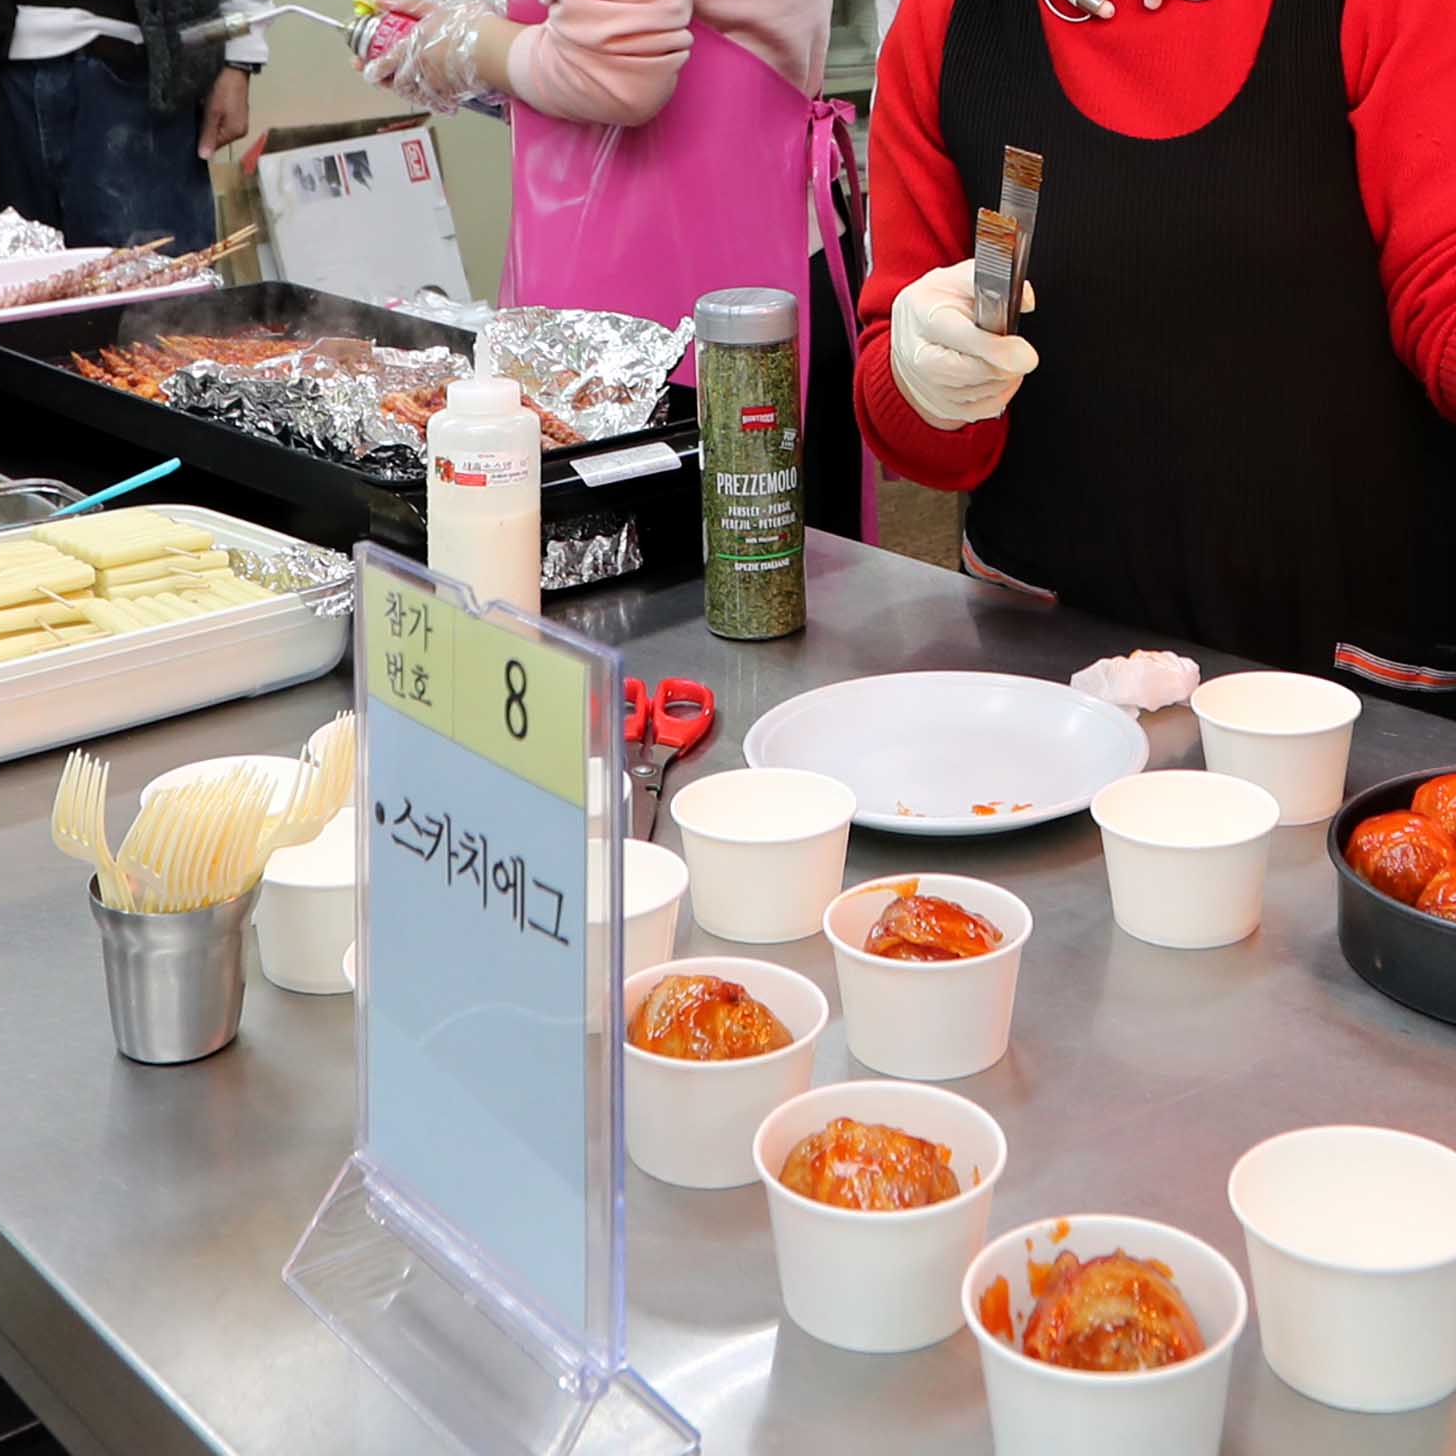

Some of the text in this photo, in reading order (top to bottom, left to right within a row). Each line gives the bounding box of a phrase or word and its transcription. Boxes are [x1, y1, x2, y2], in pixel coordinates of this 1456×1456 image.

[716, 466, 798, 496] PREZZEMOLO
[385, 591, 433, 650] 참가
[385, 651, 433, 707] 번호
[505, 659, 529, 740] 8
[391, 797, 570, 946] 스카치에그
